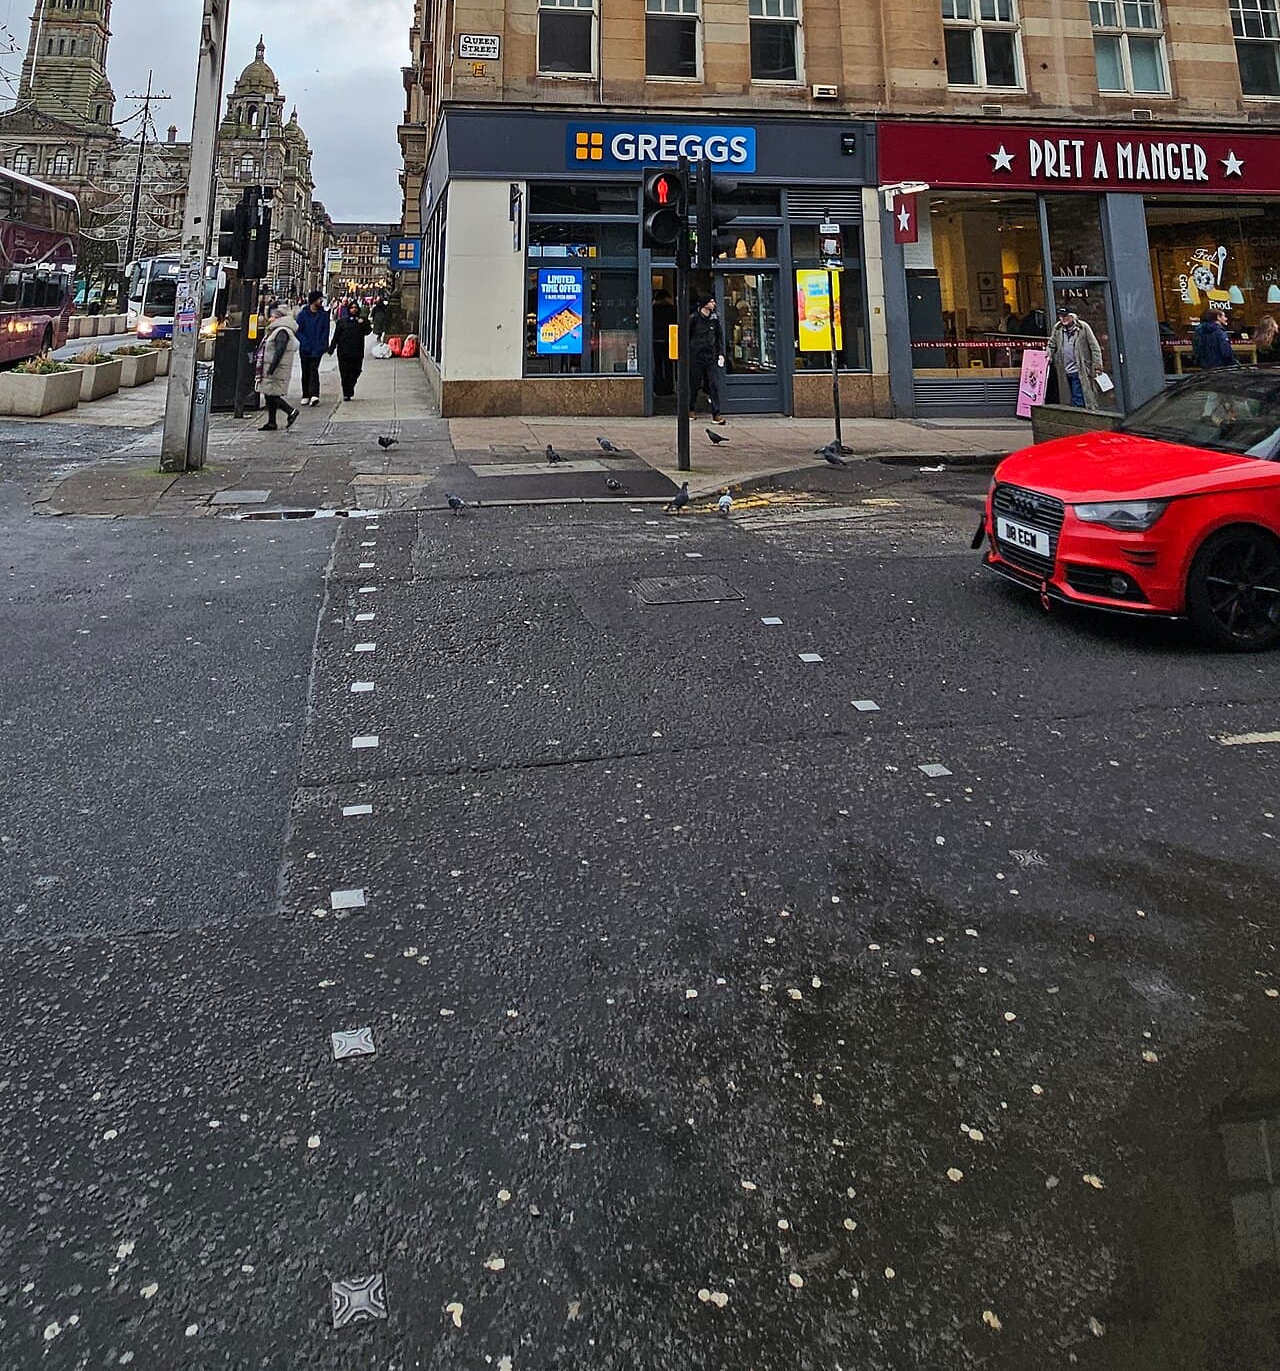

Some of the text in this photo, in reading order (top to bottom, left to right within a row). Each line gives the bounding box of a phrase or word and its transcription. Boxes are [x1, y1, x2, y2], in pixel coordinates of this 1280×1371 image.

[463, 36, 497, 45] QUEEN
[461, 44, 498, 54] STREET
[611, 133, 748, 163] GREGGS
[1029, 139, 1209, 181] PRET A MANGER
[1193, 248, 1218, 262] Feel
[547, 275, 576, 284] LIMITED
[541, 284, 582, 293] TIME OFFER
